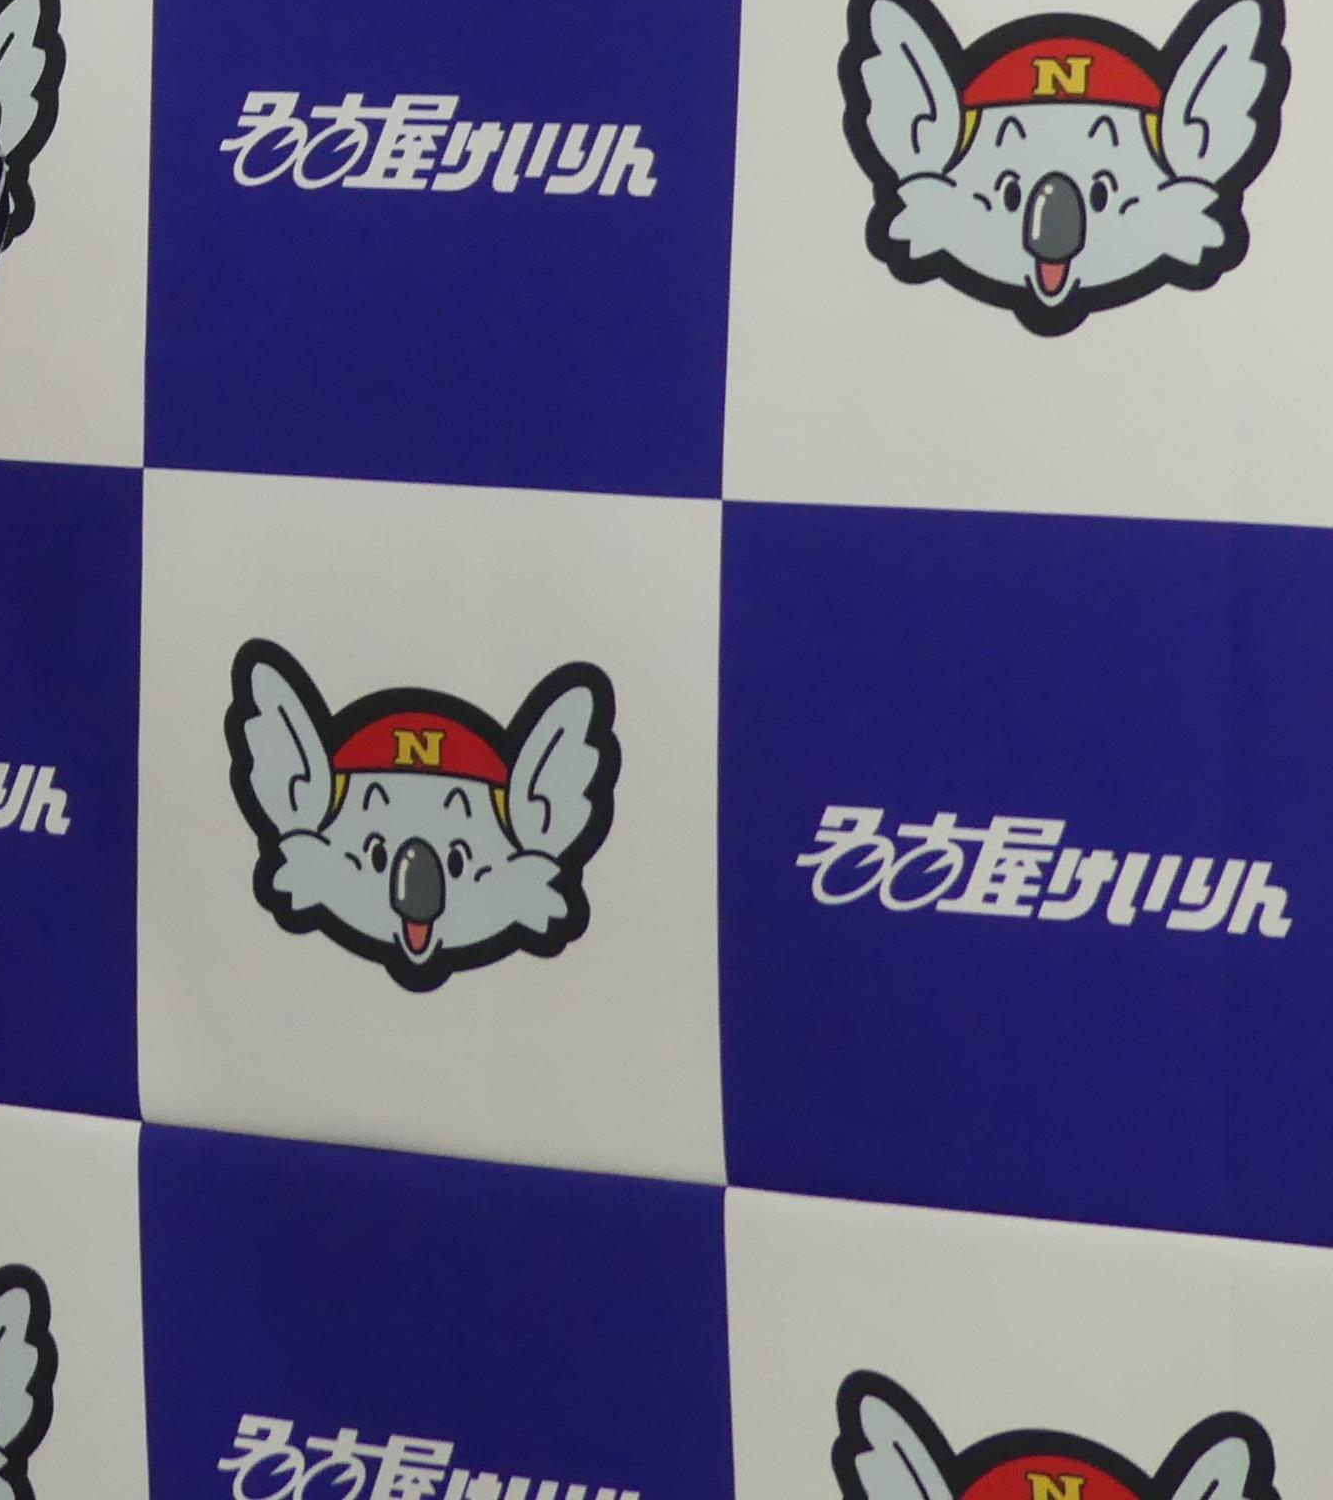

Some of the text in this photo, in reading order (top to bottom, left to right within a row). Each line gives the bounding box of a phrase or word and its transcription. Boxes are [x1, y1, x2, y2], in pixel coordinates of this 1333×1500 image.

[1035, 57, 1091, 96] N
[220, 92, 657, 196] 名古屋けいりん
[394, 731, 444, 766] N
[797, 807, 1291, 937] 名古屋けいりん
[1027, 1473, 1085, 1500] N
